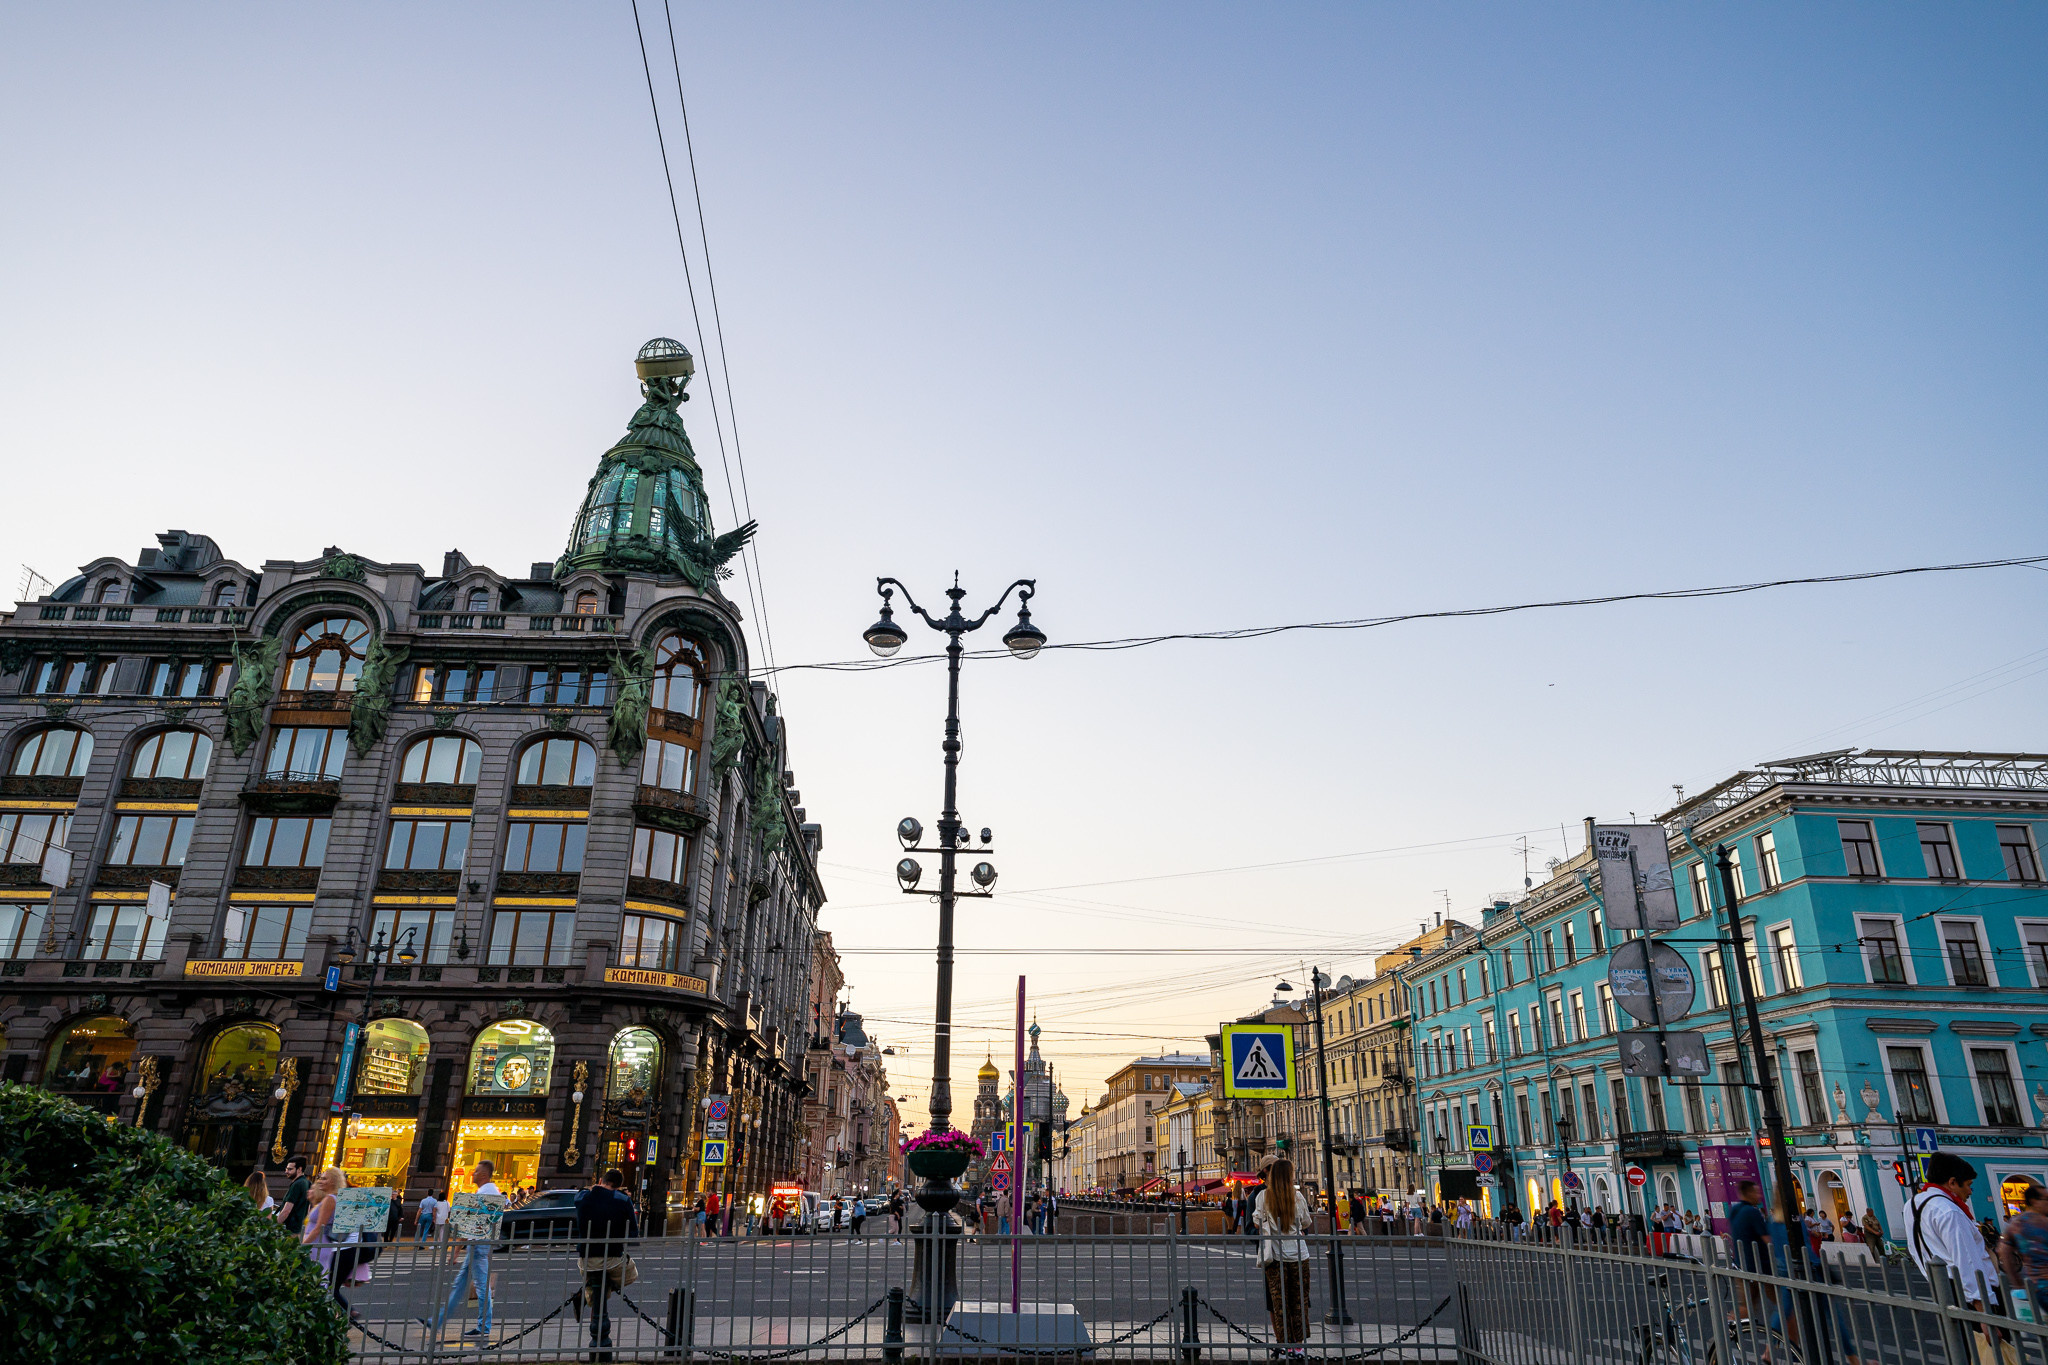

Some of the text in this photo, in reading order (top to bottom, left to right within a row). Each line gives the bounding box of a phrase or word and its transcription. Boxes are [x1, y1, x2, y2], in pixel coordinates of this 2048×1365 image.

[1598, 836, 1629, 848] ЧЕКИ
[1936, 1134, 2024, 1146] НЕВСКИЙ ПРОСПЕКТ
